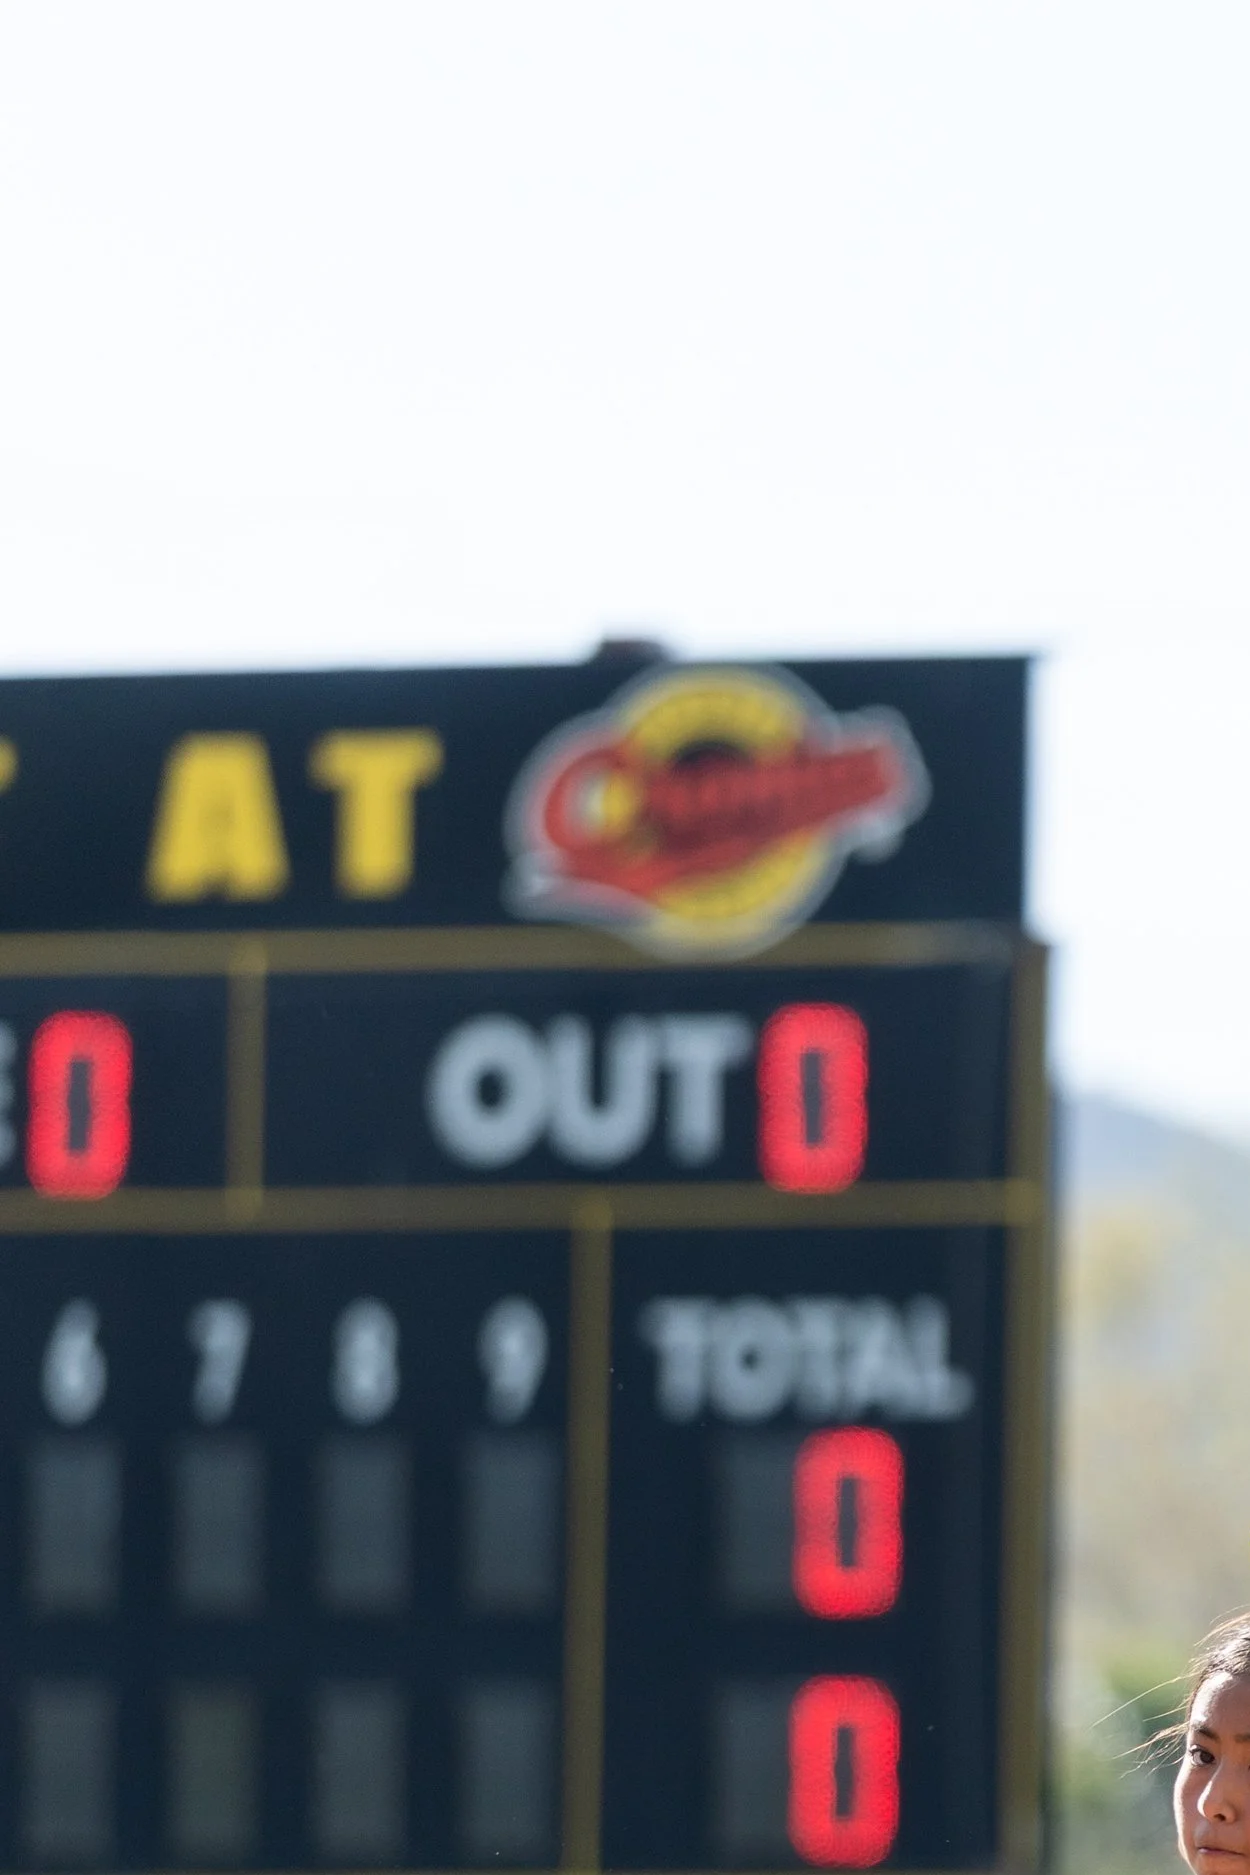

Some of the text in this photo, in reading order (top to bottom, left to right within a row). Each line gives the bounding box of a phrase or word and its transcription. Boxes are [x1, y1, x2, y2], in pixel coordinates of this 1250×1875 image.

[148, 728, 444, 903] AT
[26, 1009, 134, 1200] 0
[427, 1012, 752, 1168] OUT
[757, 1001, 868, 1194] 0
[41, 1296, 547, 1425] 6 7 8 9
[638, 1294, 975, 1424] TOTAL
[791, 1425, 904, 1619] 0
[787, 1674, 900, 1867] 0
